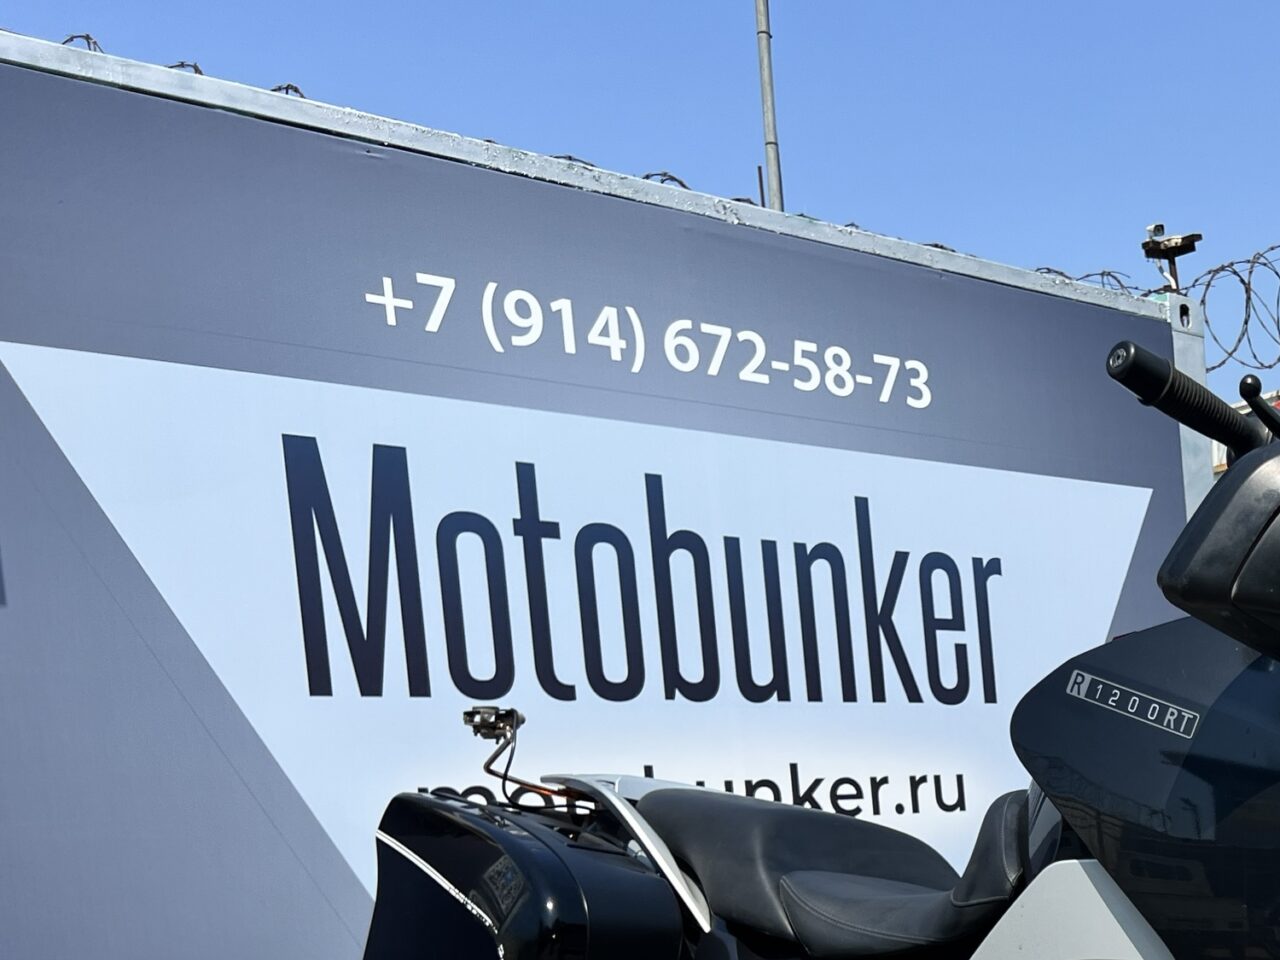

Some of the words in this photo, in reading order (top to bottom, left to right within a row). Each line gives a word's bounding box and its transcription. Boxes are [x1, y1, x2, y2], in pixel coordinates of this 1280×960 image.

[365, 272, 456, 333] +7
[481, 281, 646, 373] (914)
[663, 319, 932, 409] 672-58-73
[281, 433, 1003, 705] Motobunker
